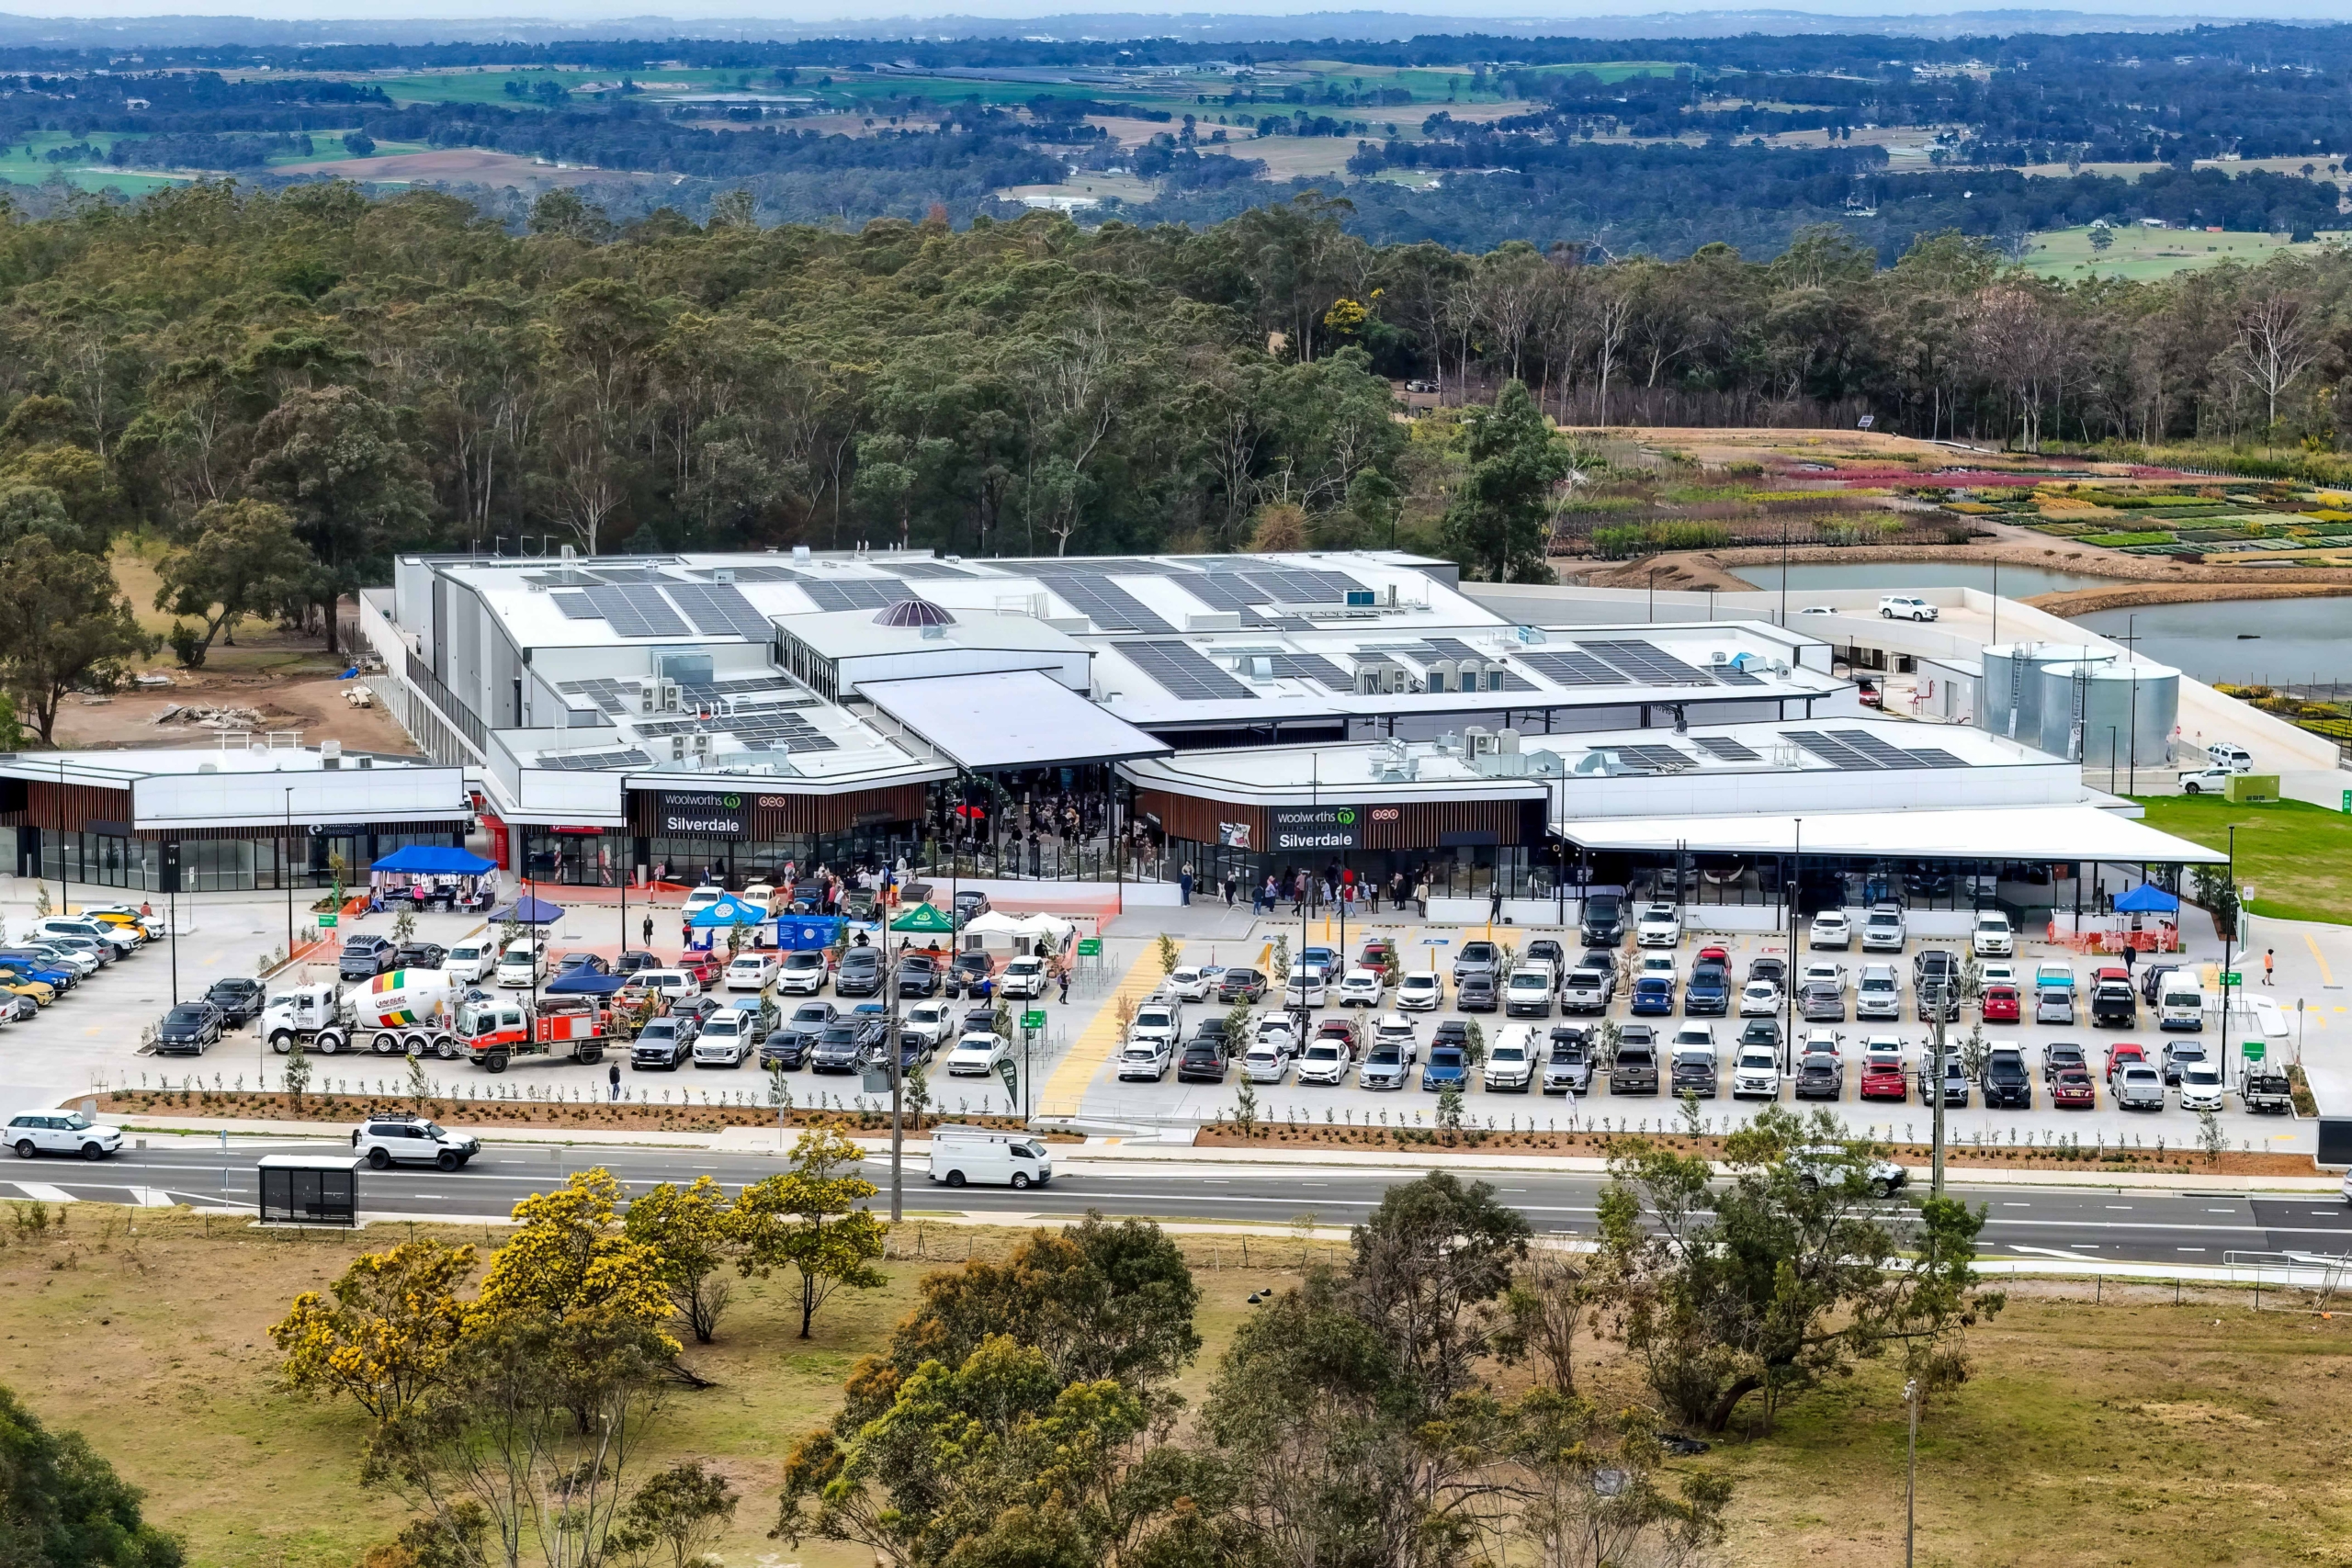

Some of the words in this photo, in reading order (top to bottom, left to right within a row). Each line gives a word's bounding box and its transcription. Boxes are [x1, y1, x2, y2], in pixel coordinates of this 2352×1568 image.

[665, 794, 722, 807] Woolworths
[667, 817, 740, 832] Silverdale
[1279, 832, 1352, 848] Silverdale
